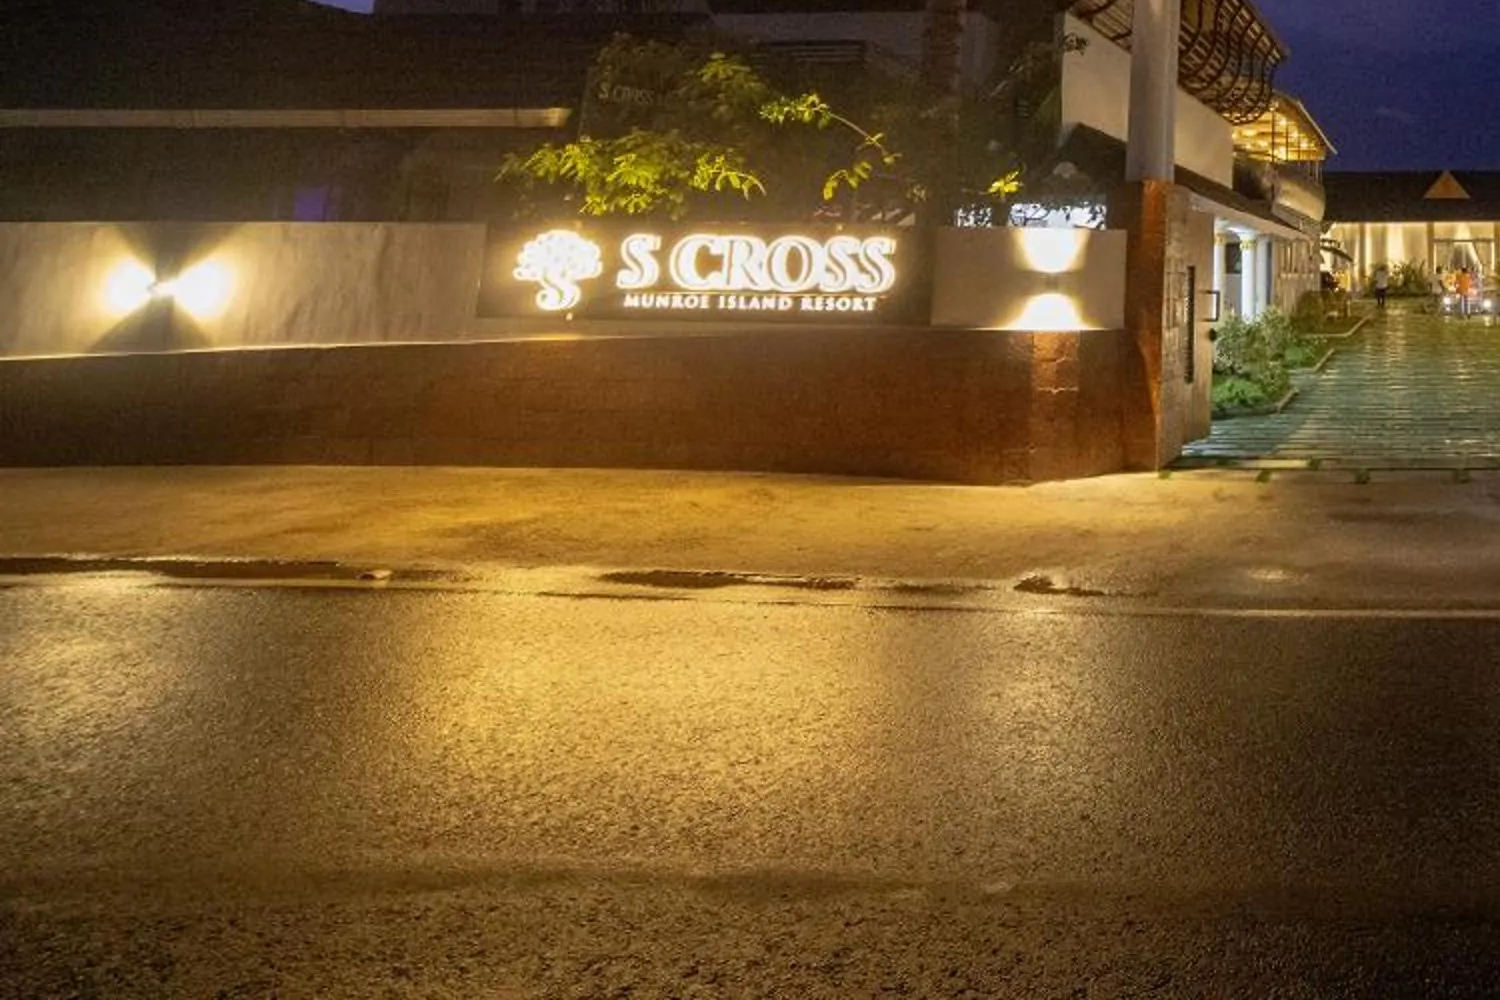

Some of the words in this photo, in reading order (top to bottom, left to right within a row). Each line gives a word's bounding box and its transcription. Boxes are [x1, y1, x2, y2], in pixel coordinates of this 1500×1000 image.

[616, 233, 661, 290] S
[669, 233, 898, 293] CROSS
[623, 294, 710, 310] MUNROE
[718, 295, 793, 311] ISLAND
[800, 296, 877, 312] RESORT
